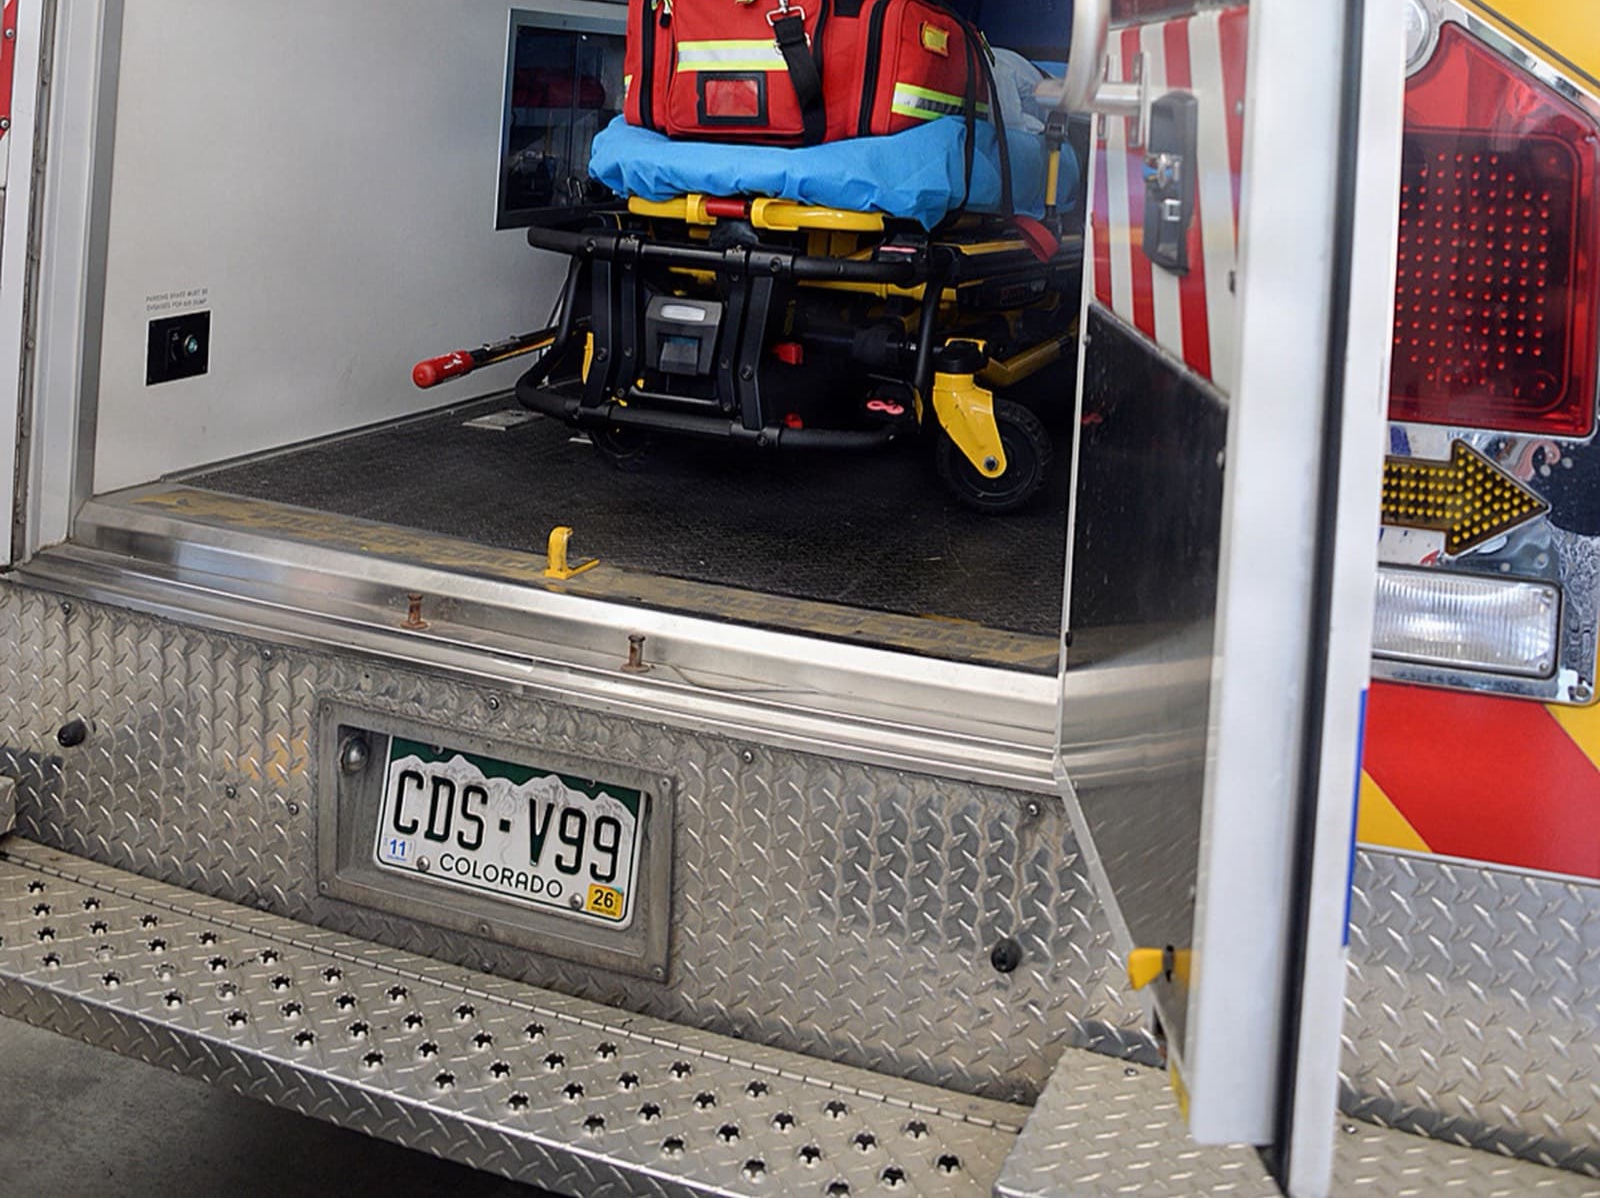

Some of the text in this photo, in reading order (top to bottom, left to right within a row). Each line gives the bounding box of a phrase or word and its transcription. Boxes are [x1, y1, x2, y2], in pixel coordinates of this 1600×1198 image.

[390, 839, 406, 857] 11
[439, 853, 564, 898] COLORADO
[592, 889, 614, 908] 26
